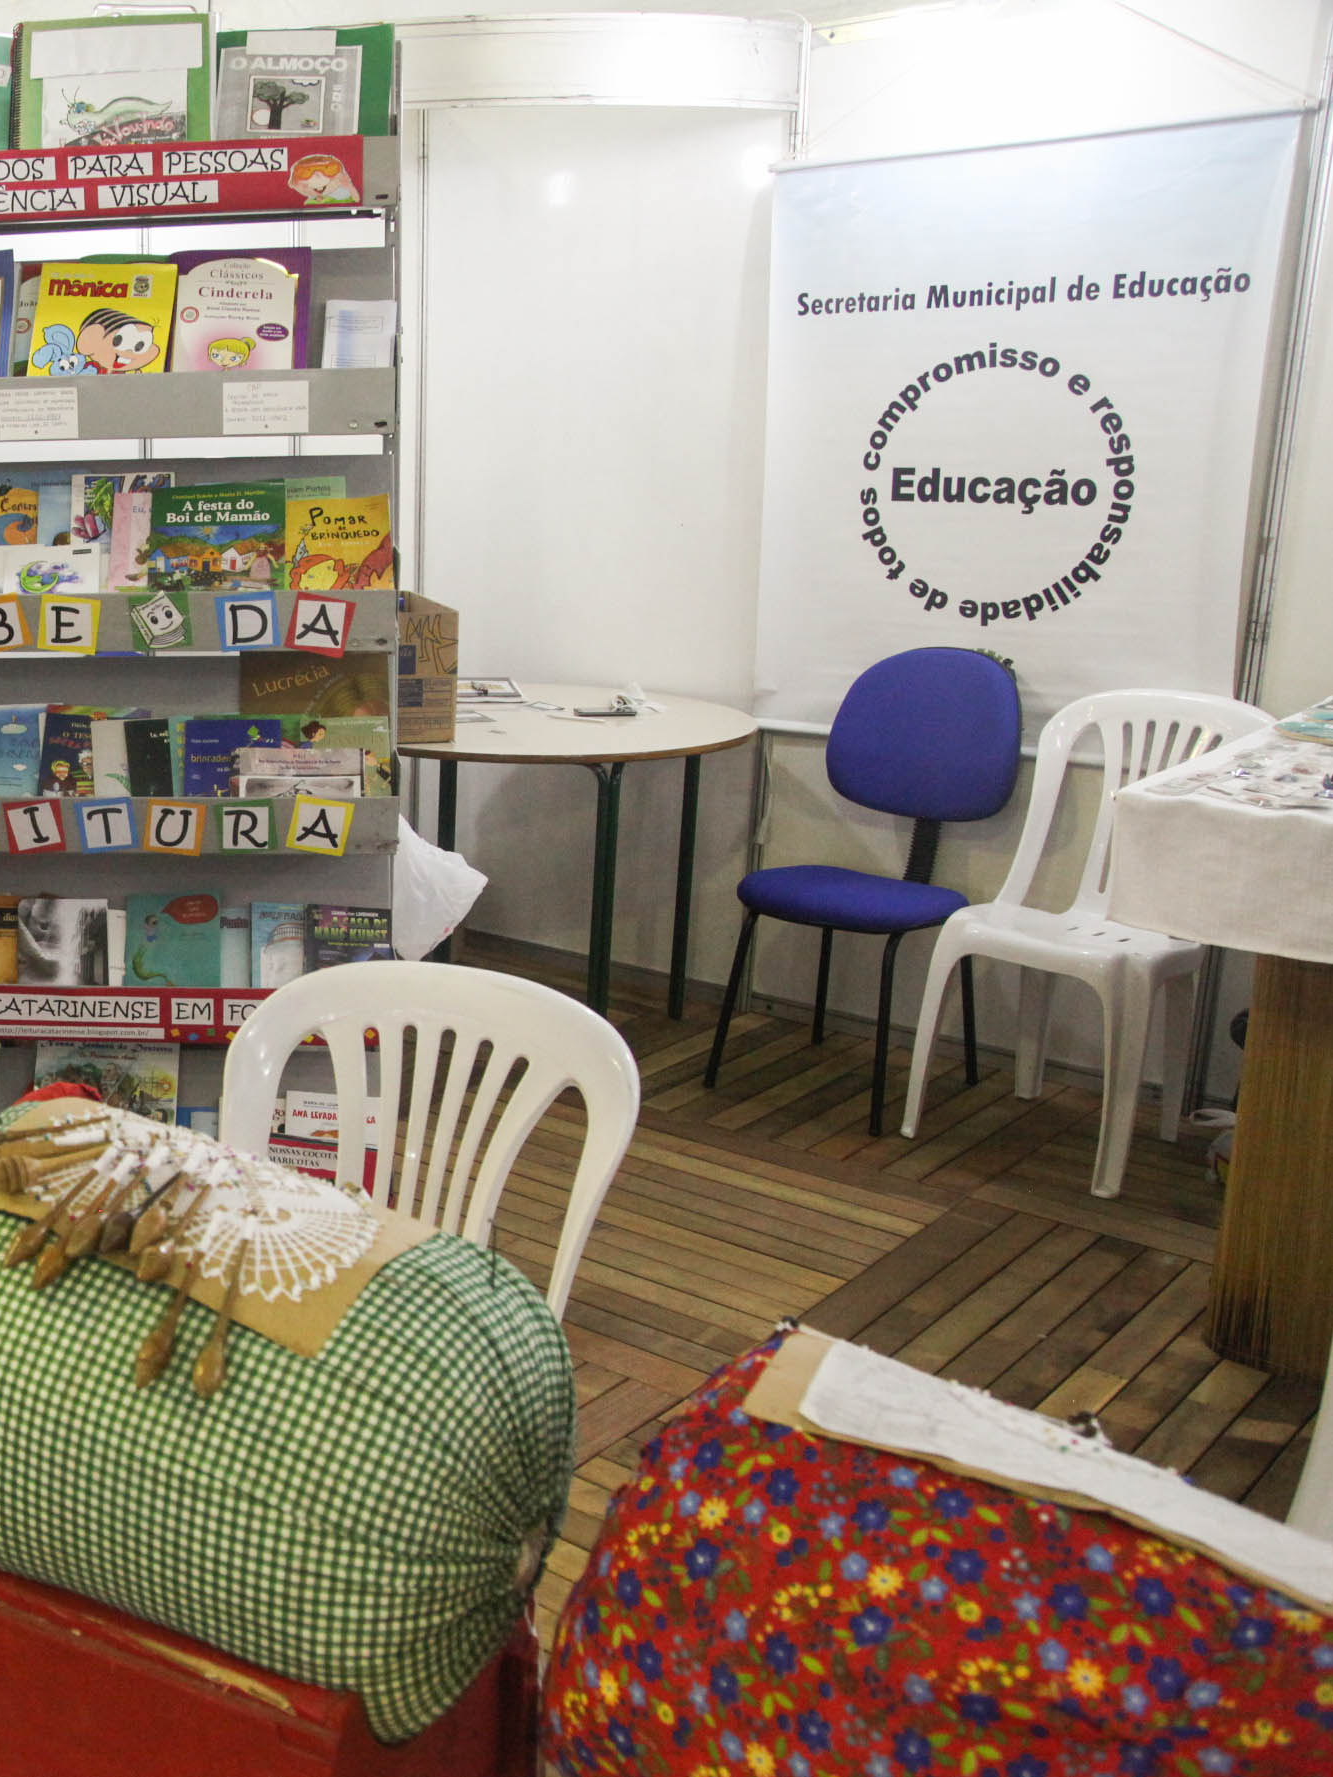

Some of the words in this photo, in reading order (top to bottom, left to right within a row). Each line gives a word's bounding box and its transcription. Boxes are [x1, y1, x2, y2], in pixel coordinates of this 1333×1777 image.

[250, 56, 348, 73] ALMOÇO
[70, 153, 144, 179] PARA
[165, 148, 284, 174] PESSOAS
[109, 181, 208, 208] VISUAL
[210, 268, 264, 280] Clássicos
[198, 286, 273, 300] Cinderela
[796, 286, 916, 317] Secretaria
[926, 276, 1057, 312] Municipal
[1067, 273, 1101, 302] de
[1111, 265, 1252, 303] Educação
[1068, 371, 1092, 397] e
[862, 341, 1062, 472] compromisso
[890, 466, 1098, 516] Educação
[166, 512, 190, 523] Boi
[194, 512, 212, 522] de
[216, 510, 270, 523] Mamão
[182, 501, 193, 511] A
[198, 499, 232, 511] festa
[236, 499, 254, 510] do
[958, 395, 1137, 627] responsabilidade
[859, 486, 907, 582] todos
[908, 576, 950, 613] de
[229, 603, 340, 647] DA
[175, 1001, 212, 1021] EM
[292, 1108, 307, 1118] ANA
[310, 1111, 338, 1121] LEVADA
[268, 1146, 301, 1157] NOSSAS
[302, 1149, 339, 1161] COCOTA
